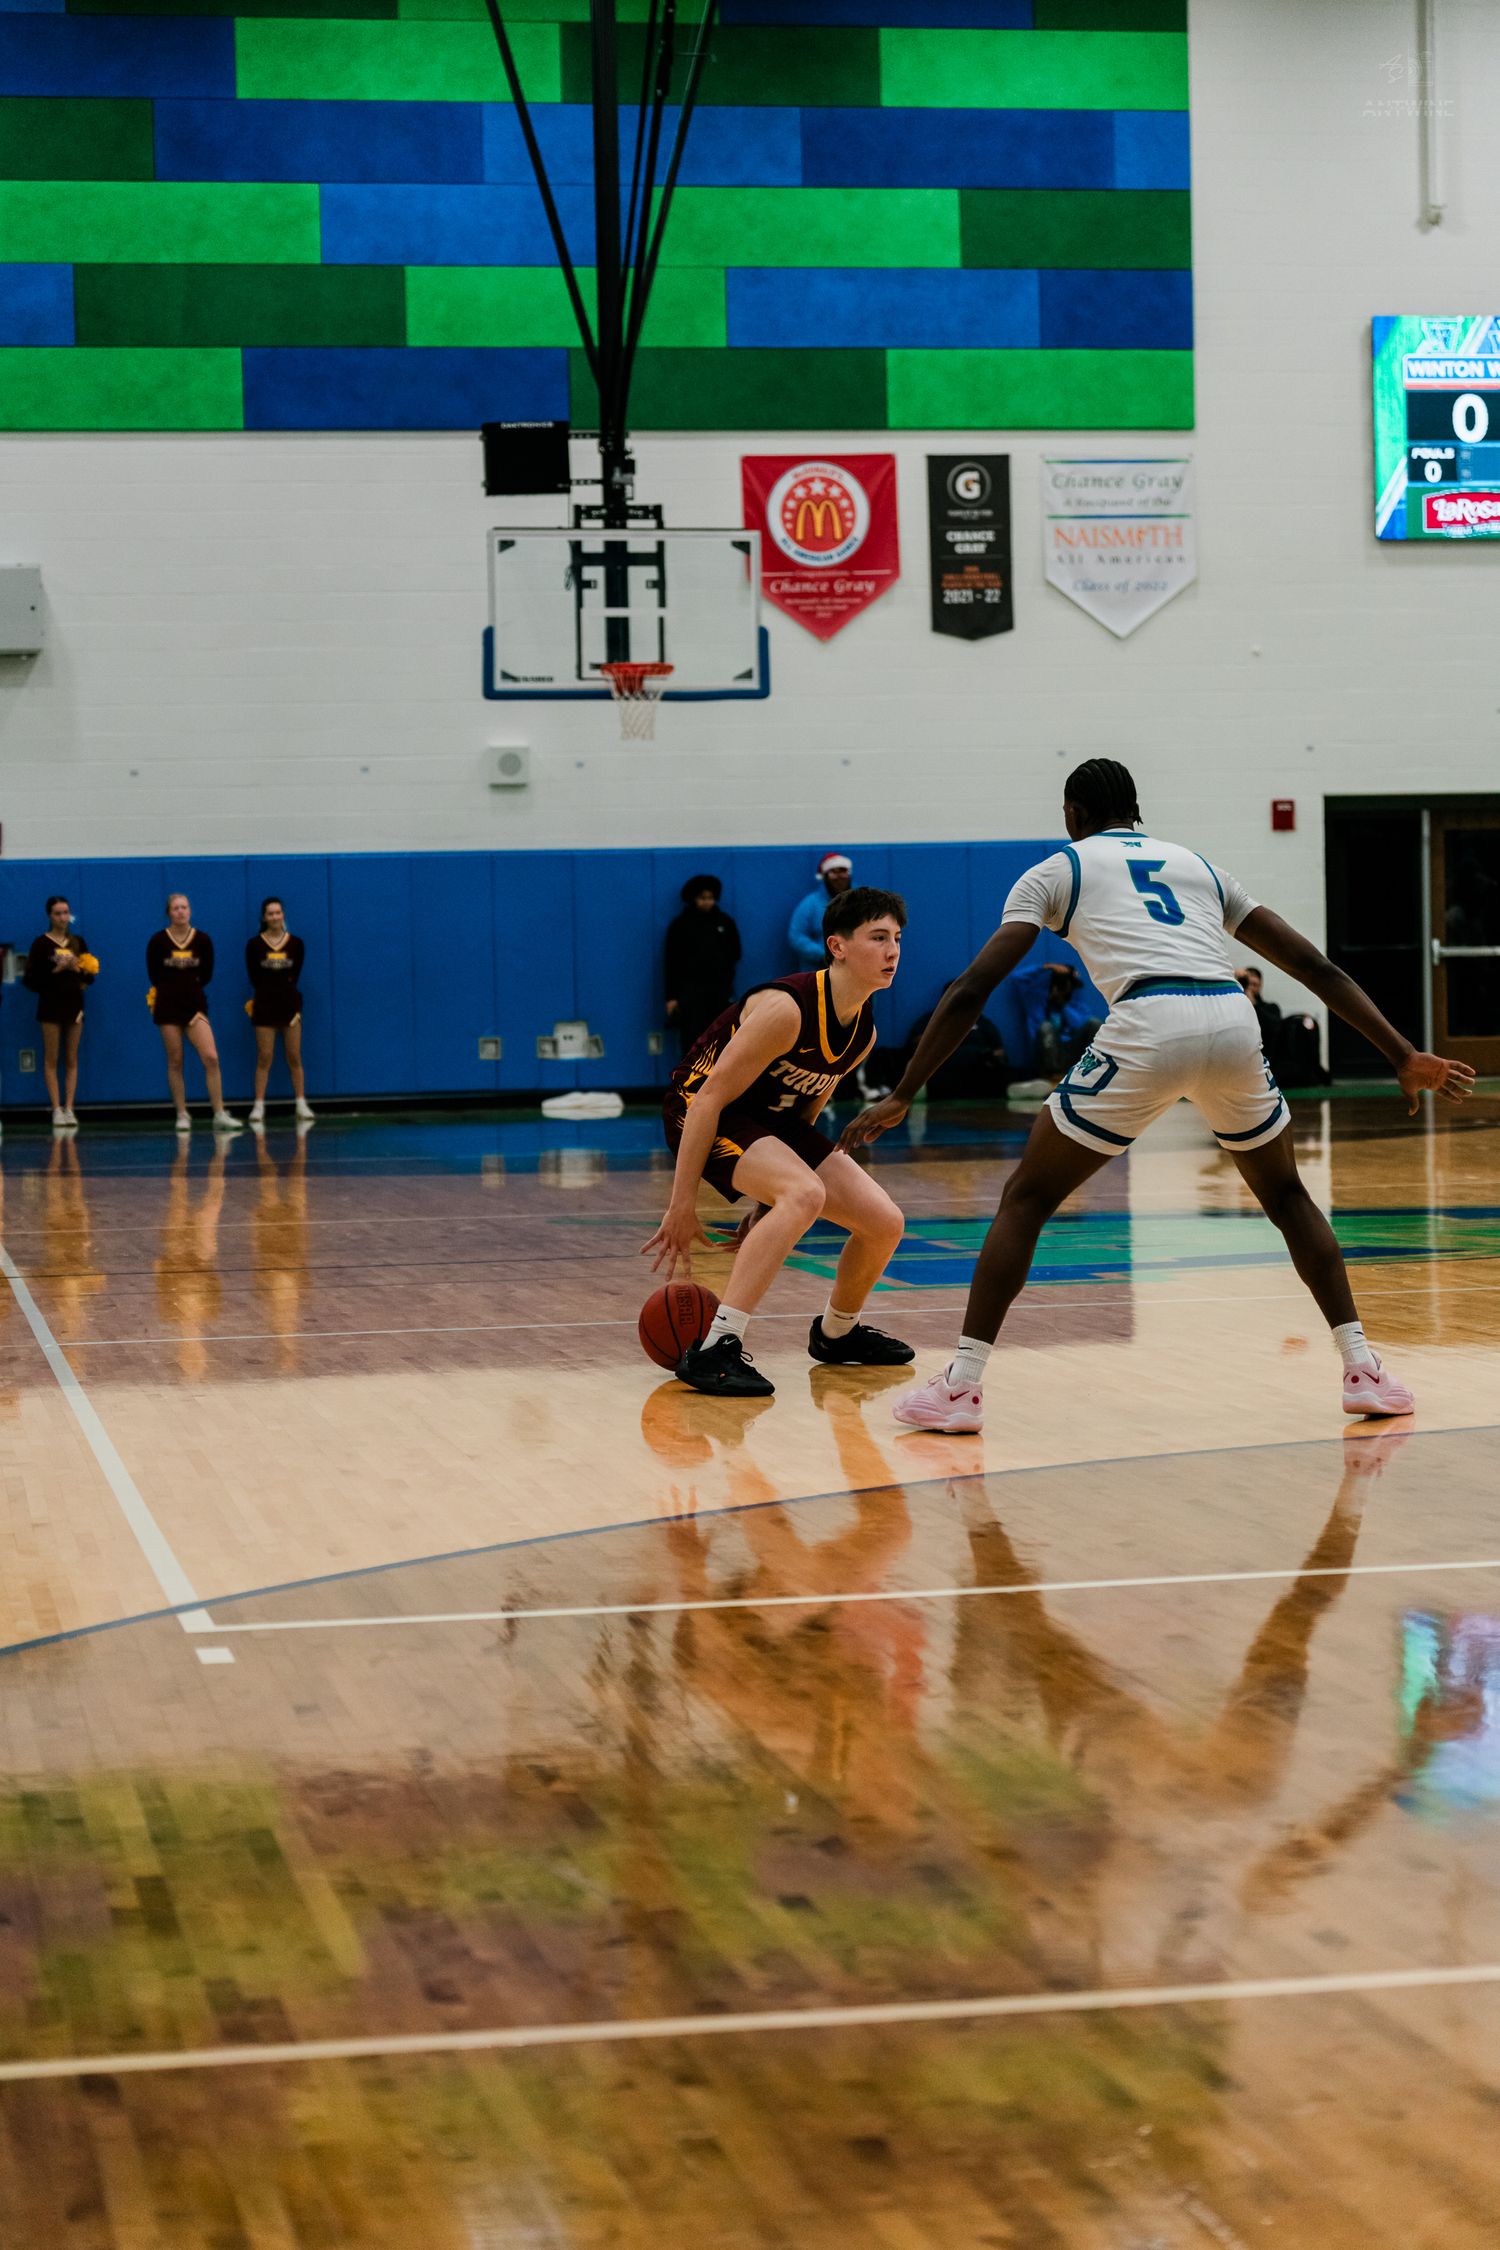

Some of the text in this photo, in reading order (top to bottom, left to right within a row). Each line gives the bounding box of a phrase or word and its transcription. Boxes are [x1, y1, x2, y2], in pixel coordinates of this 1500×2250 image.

[1408, 360, 1485, 378] WINTON
[1452, 393, 1489, 443] 0
[1424, 460, 1442, 483] 0
[1051, 472, 1183, 494] Chance Gray
[945, 531, 996, 542] CHANCE
[1055, 525, 1183, 549] NAISMITH
[954, 543, 987, 554] GRAY
[1097, 554, 1186, 564] American
[770, 577, 876, 596] Chance Gray
[1072, 579, 1110, 592] Class
[943, 588, 974, 604] 2021
[984, 588, 1001, 603] 22
[1125, 858, 1186, 926] 5
